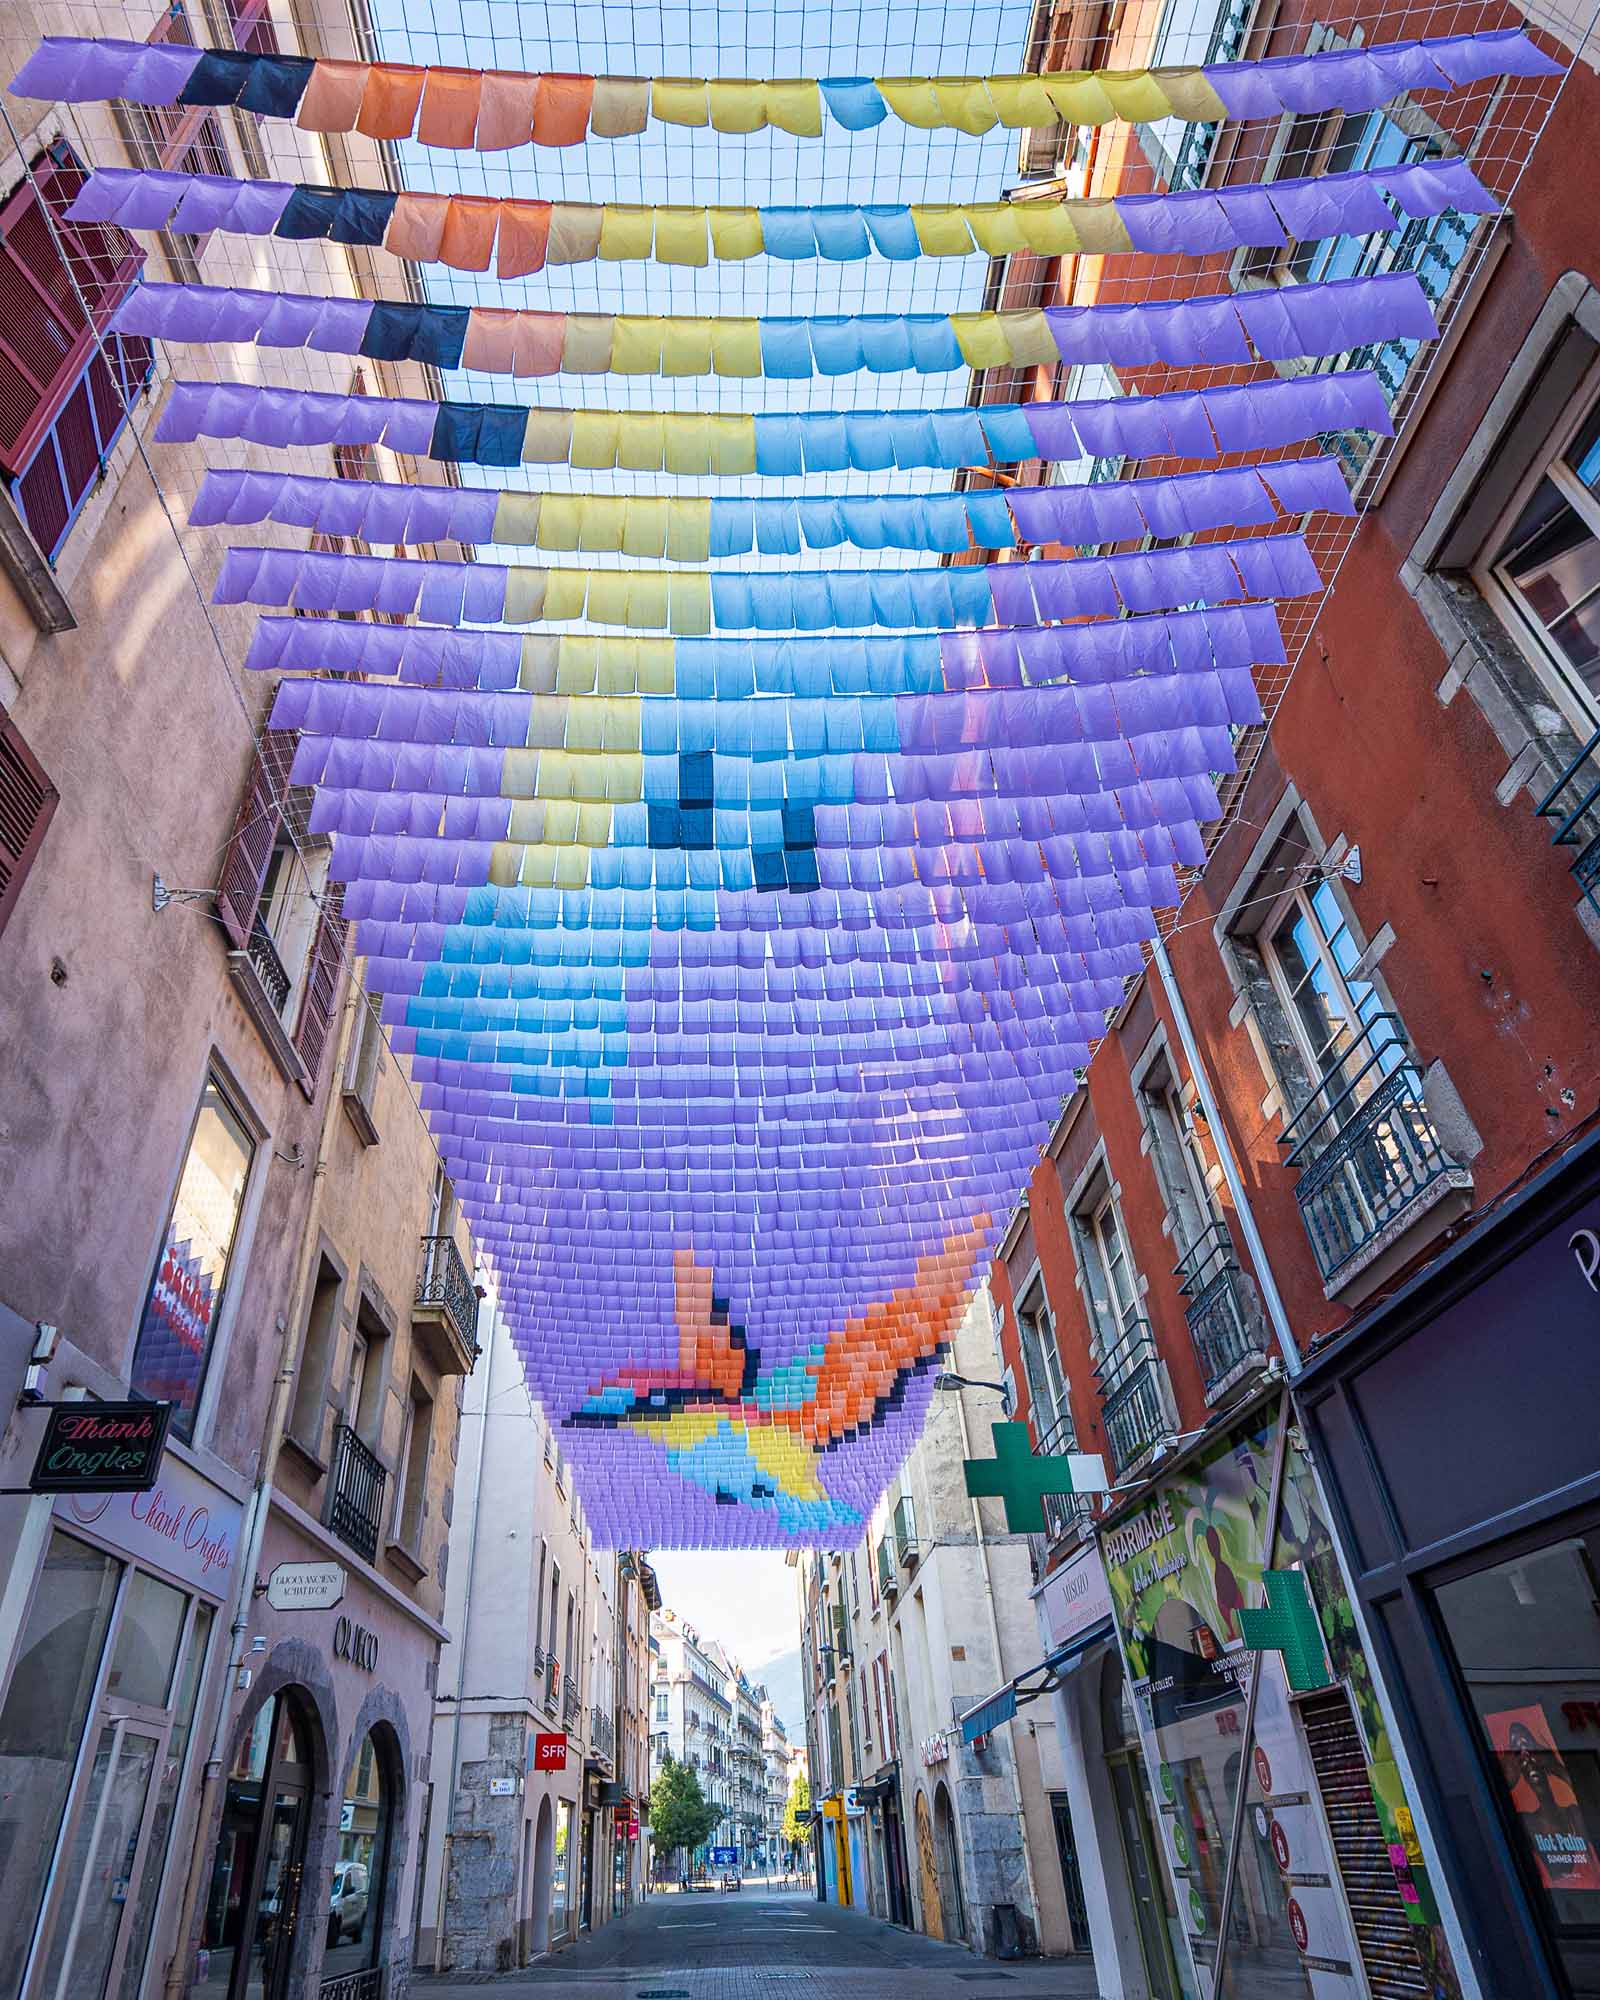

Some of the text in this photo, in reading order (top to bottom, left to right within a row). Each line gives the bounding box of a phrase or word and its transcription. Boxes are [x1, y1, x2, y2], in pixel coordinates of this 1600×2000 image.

[1567, 1229, 1600, 1292] P
[48, 1442, 146, 1475] Ongles
[184, 1507, 231, 1574] Ongles
[1104, 1499, 1178, 1573] PHARMACIE
[1223, 1671, 1234, 1684] EN
[541, 1744, 566, 1758] SFR
[1546, 1854, 1572, 1865] SUMMER
